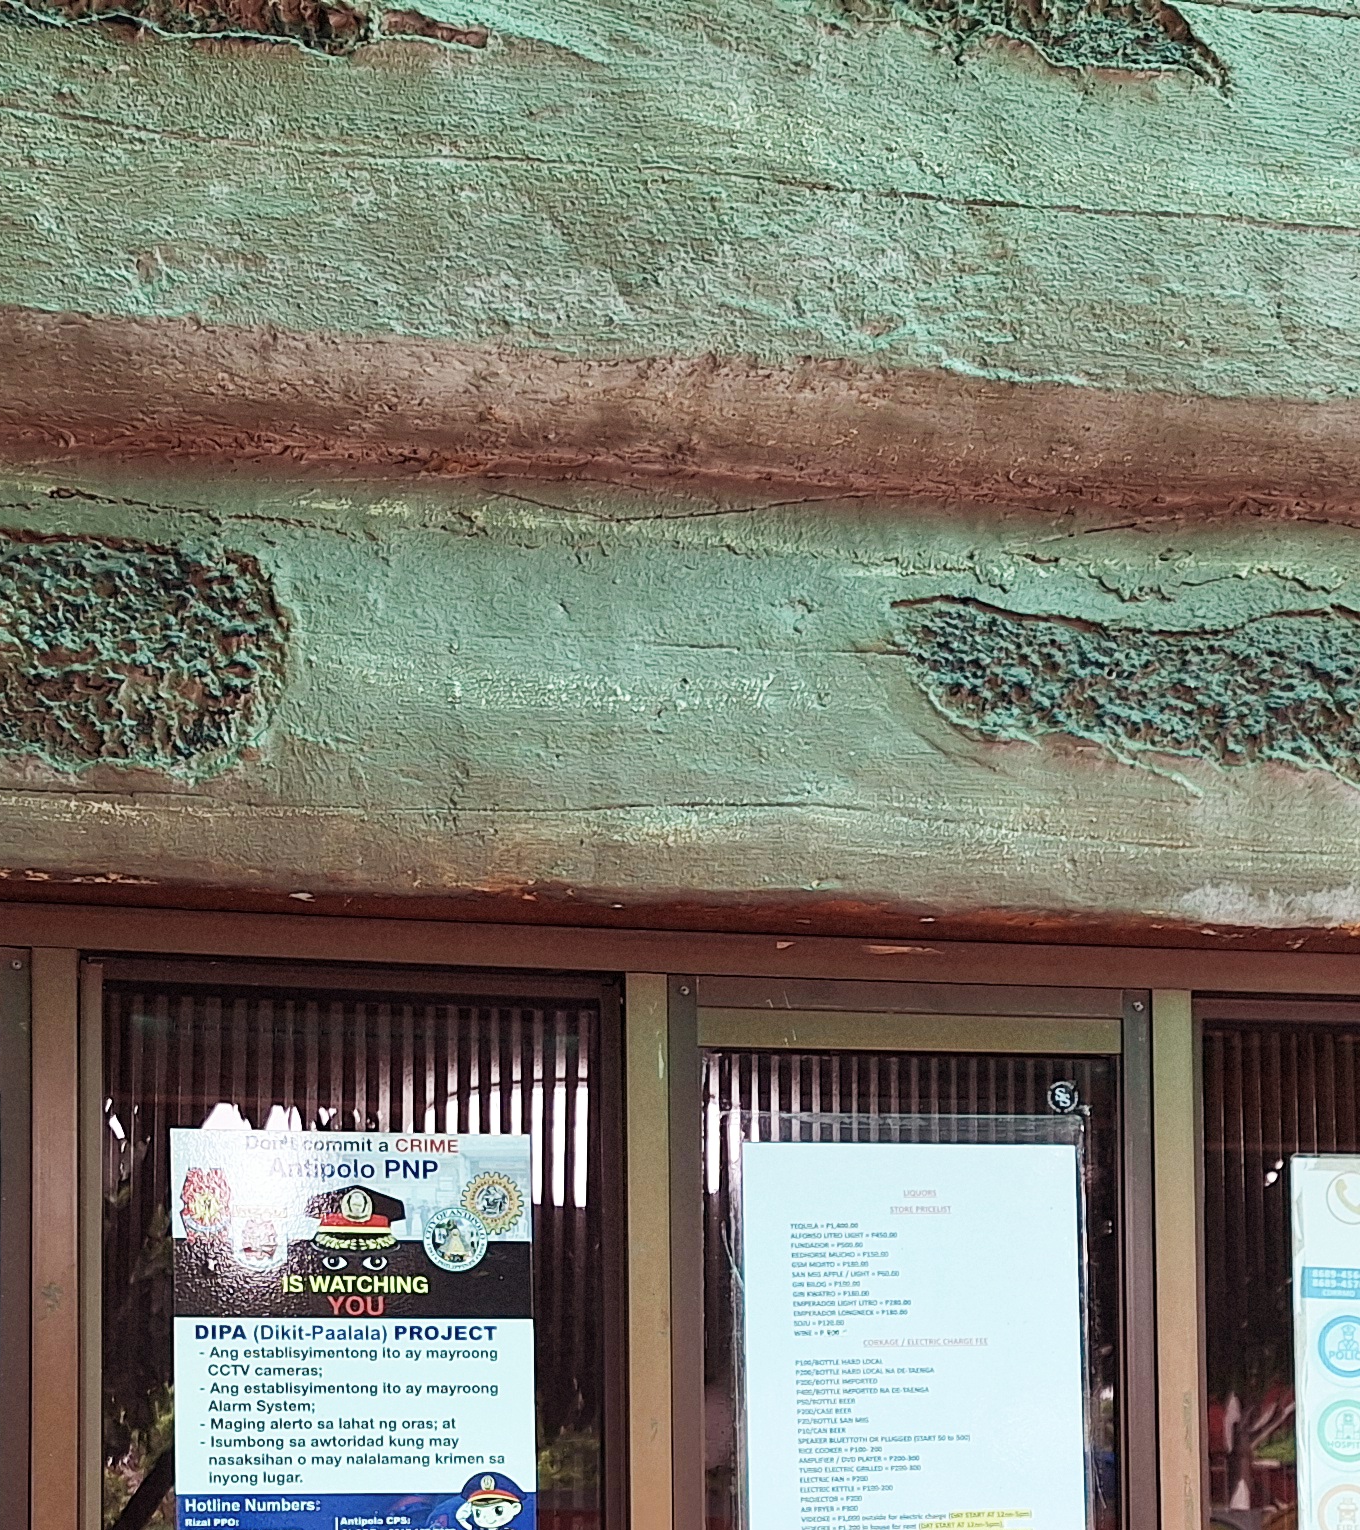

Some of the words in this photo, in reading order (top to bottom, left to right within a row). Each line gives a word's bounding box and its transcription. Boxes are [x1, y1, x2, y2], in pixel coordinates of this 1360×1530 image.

[379, 1141, 389, 1152] a
[396, 1139, 458, 1153] CRIME
[384, 1160, 439, 1179] PNP
[903, 1190, 936, 1198] LIQUORS
[282, 1276, 305, 1293] IS
[309, 1275, 429, 1294] WATCHING
[328, 1296, 385, 1315] YOU
[195, 1325, 246, 1339] DIPA
[254, 1325, 387, 1342] (Dikit-Paalala)
[395, 1326, 497, 1340] PROJECT
[210, 1347, 238, 1361] Ang
[406, 1350, 421, 1361] ay
[427, 1350, 497, 1361] mayroong
[208, 1364, 249, 1376] CCTV
[255, 1367, 322, 1377] cameras;
[211, 1418, 265, 1432] Maging
[271, 1418, 312, 1429] alerto
[318, 1421, 333, 1429] sa
[339, 1418, 374, 1429] lahat
[380, 1421, 396, 1432] ng
[402, 1421, 437, 1430] oras;
[443, 1418, 455, 1429] at
[185, 1499, 240, 1512] Hotline
[245, 1498, 320, 1511] Numbers:
